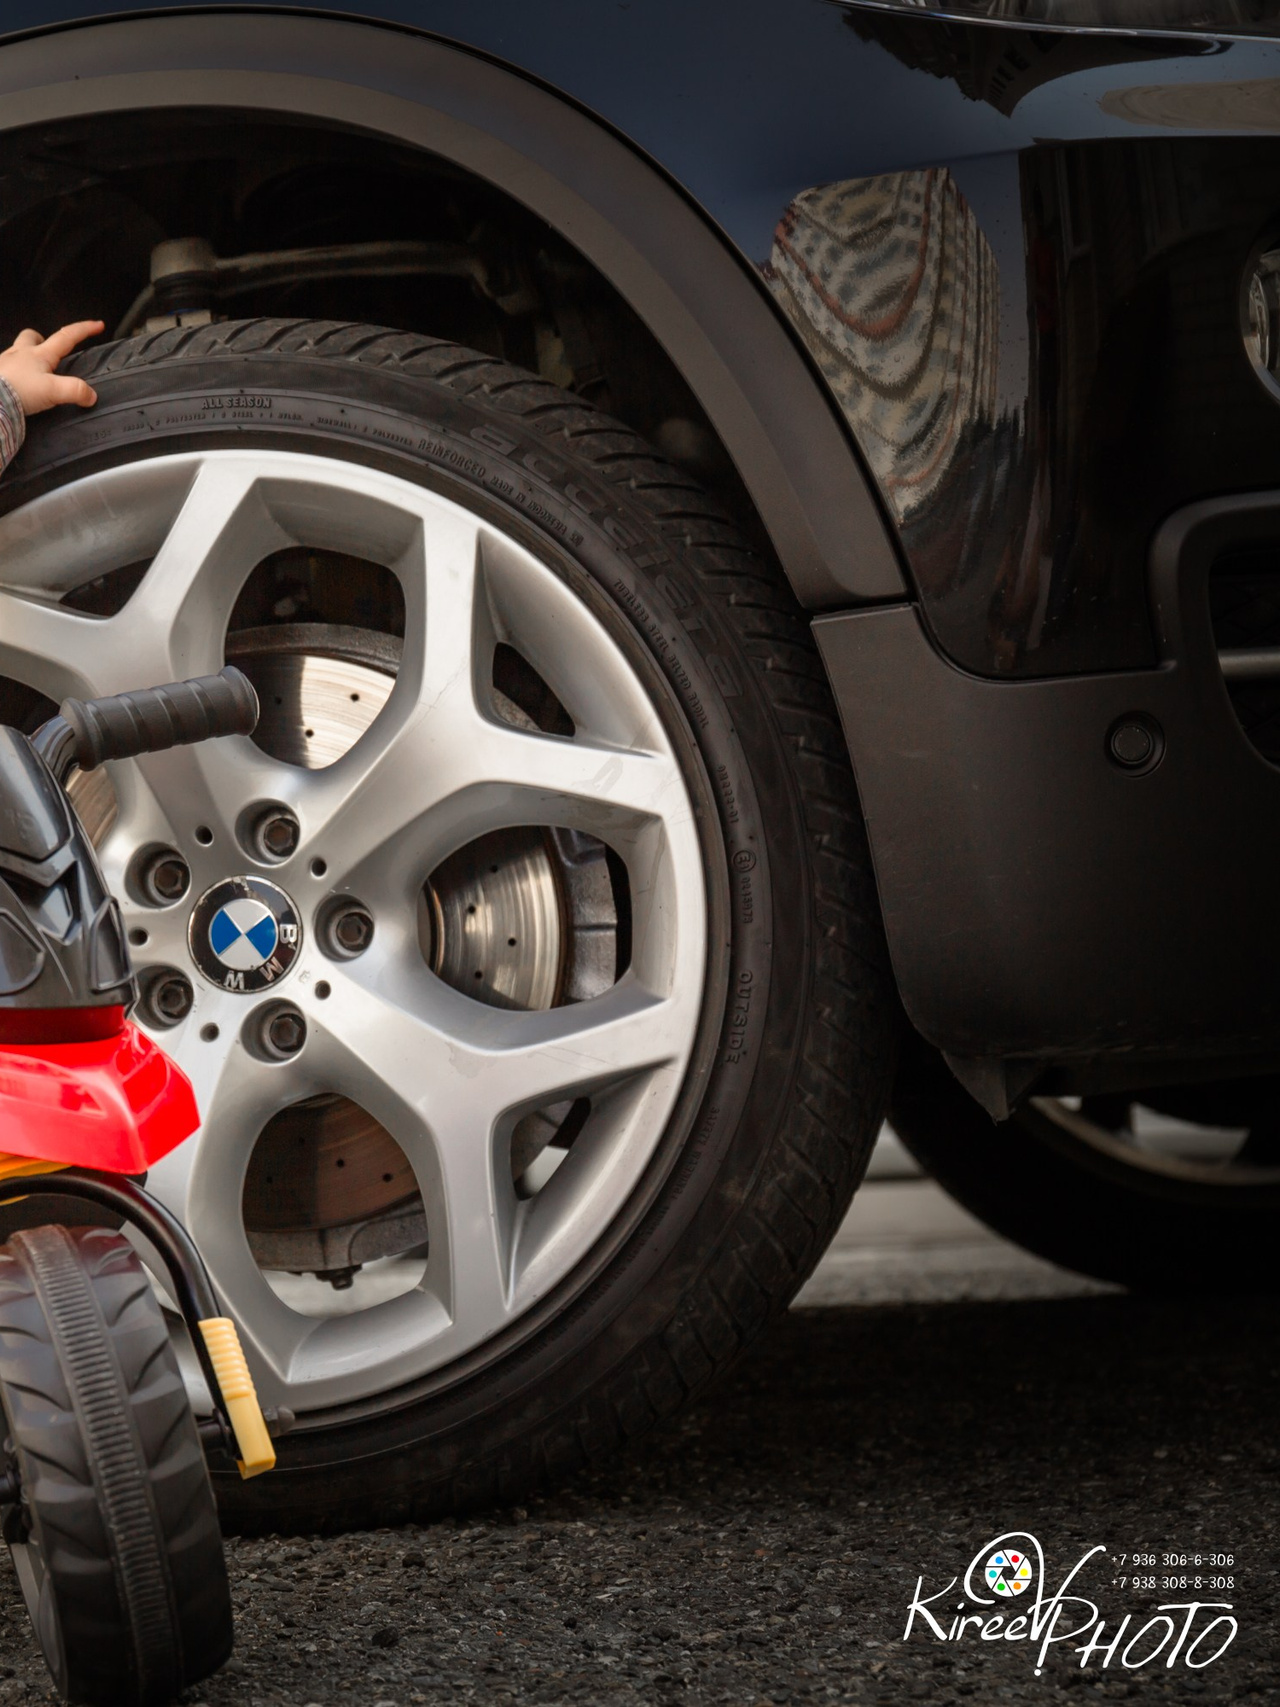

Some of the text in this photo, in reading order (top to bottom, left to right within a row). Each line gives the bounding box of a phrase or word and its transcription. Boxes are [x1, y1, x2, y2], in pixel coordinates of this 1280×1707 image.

[201, 395, 272, 410] ALL SEASON
[418, 438, 486, 478] REINFORCED
[489, 474, 514, 495] MADE
[515, 490, 526, 503] IN
[527, 499, 568, 535] INDONESIA
[612, 578, 709, 729] TUBELESS STEEL BELTED RADIAL
[722, 969, 755, 1066] OUTSIDE
